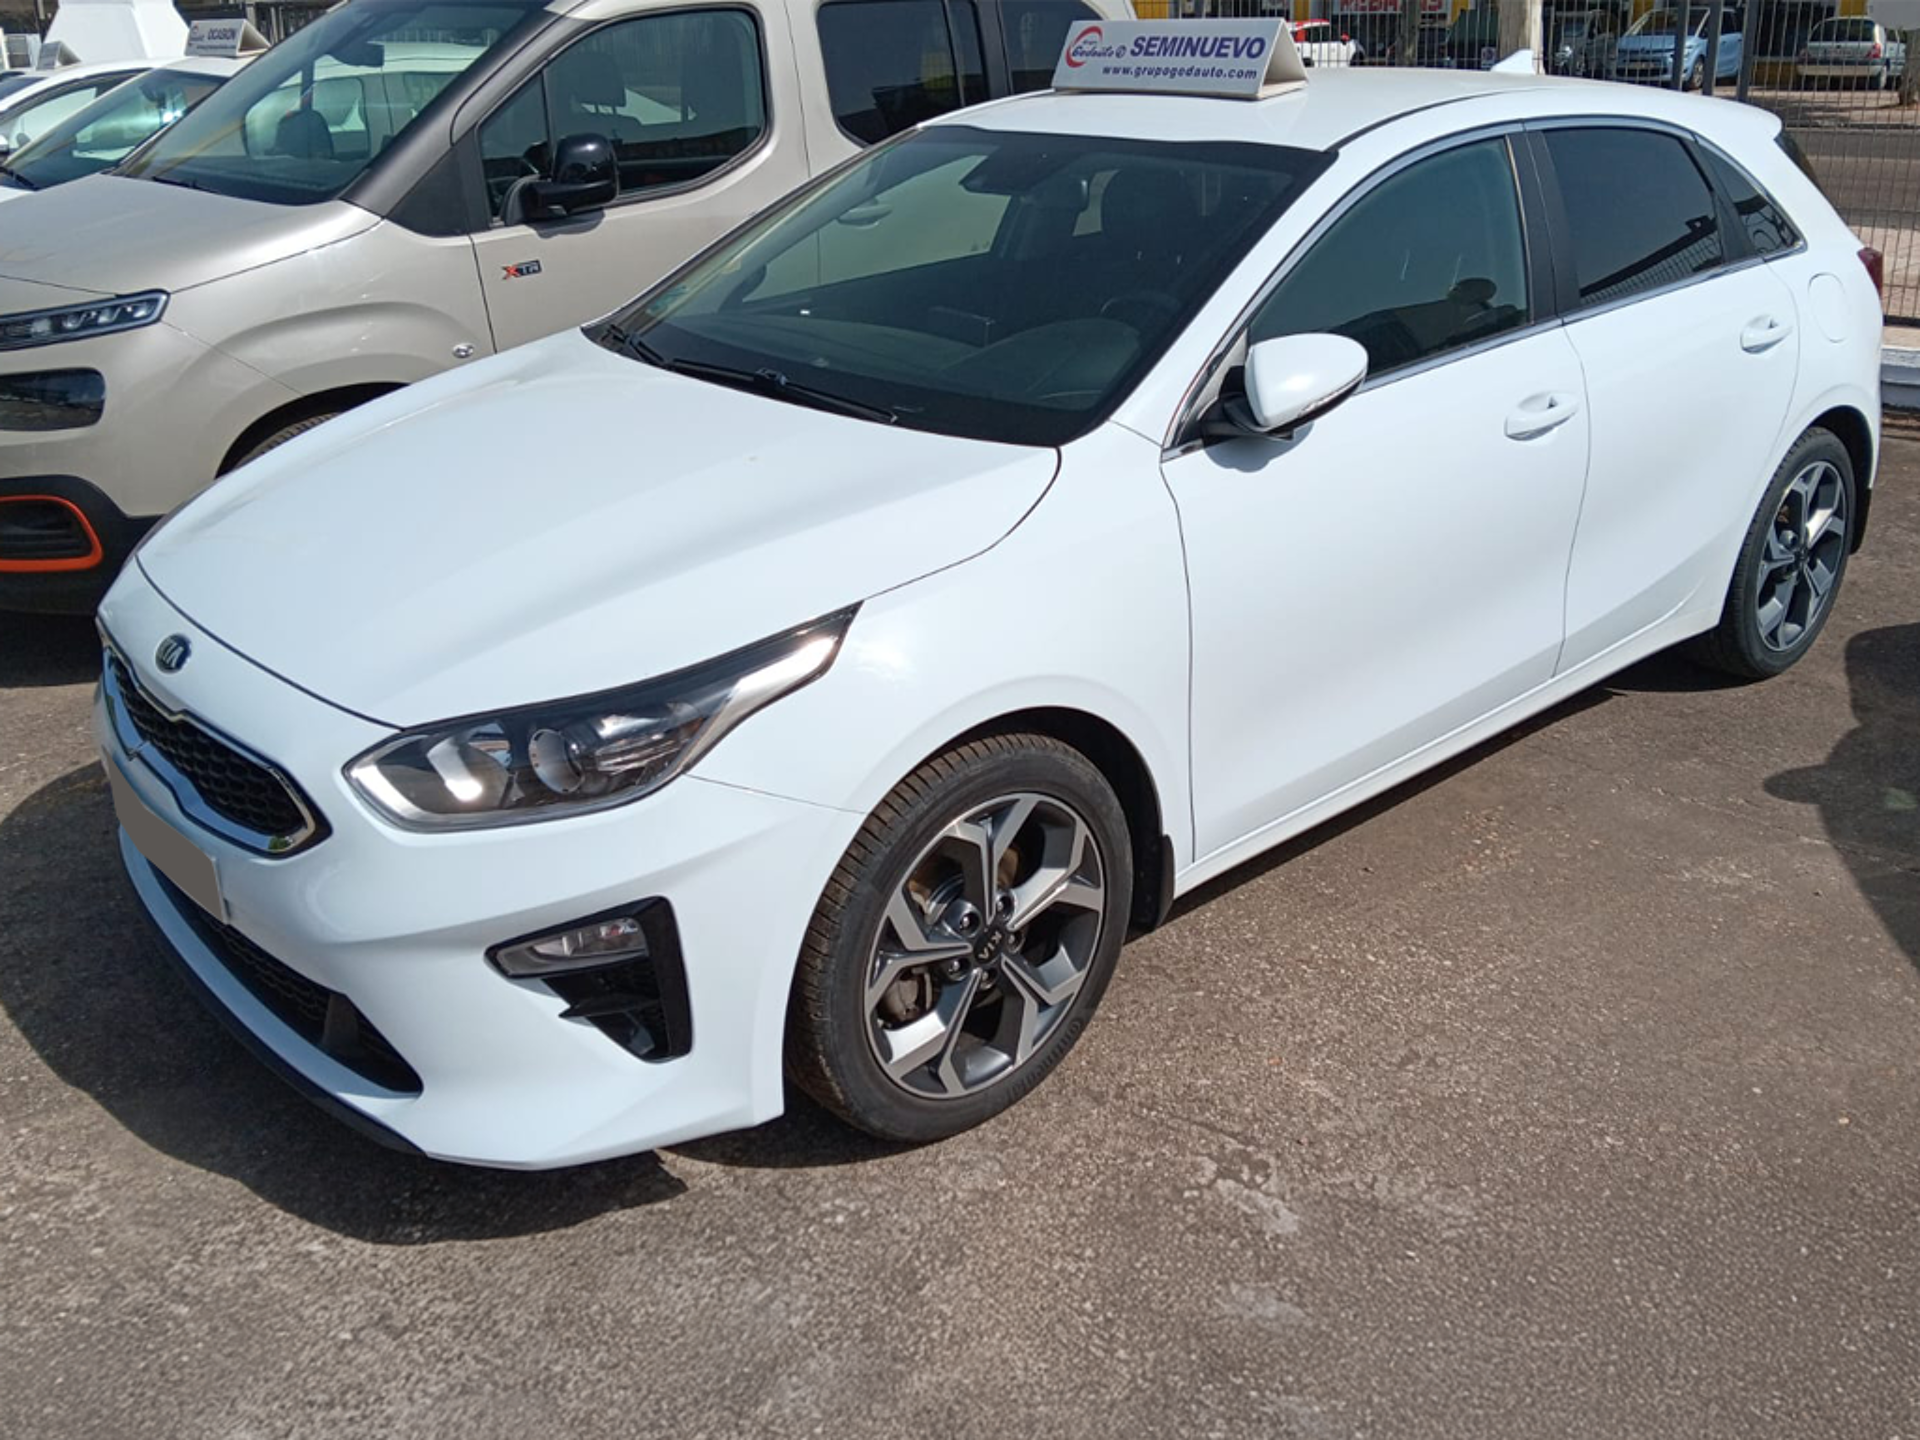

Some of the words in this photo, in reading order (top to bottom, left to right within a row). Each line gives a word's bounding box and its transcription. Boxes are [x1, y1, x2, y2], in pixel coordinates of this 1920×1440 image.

[1130, 36, 1266, 59] SEMINUEVO
[1102, 65, 1258, 79] www.grupogedauto.com
[978, 930, 1003, 960] KIA
